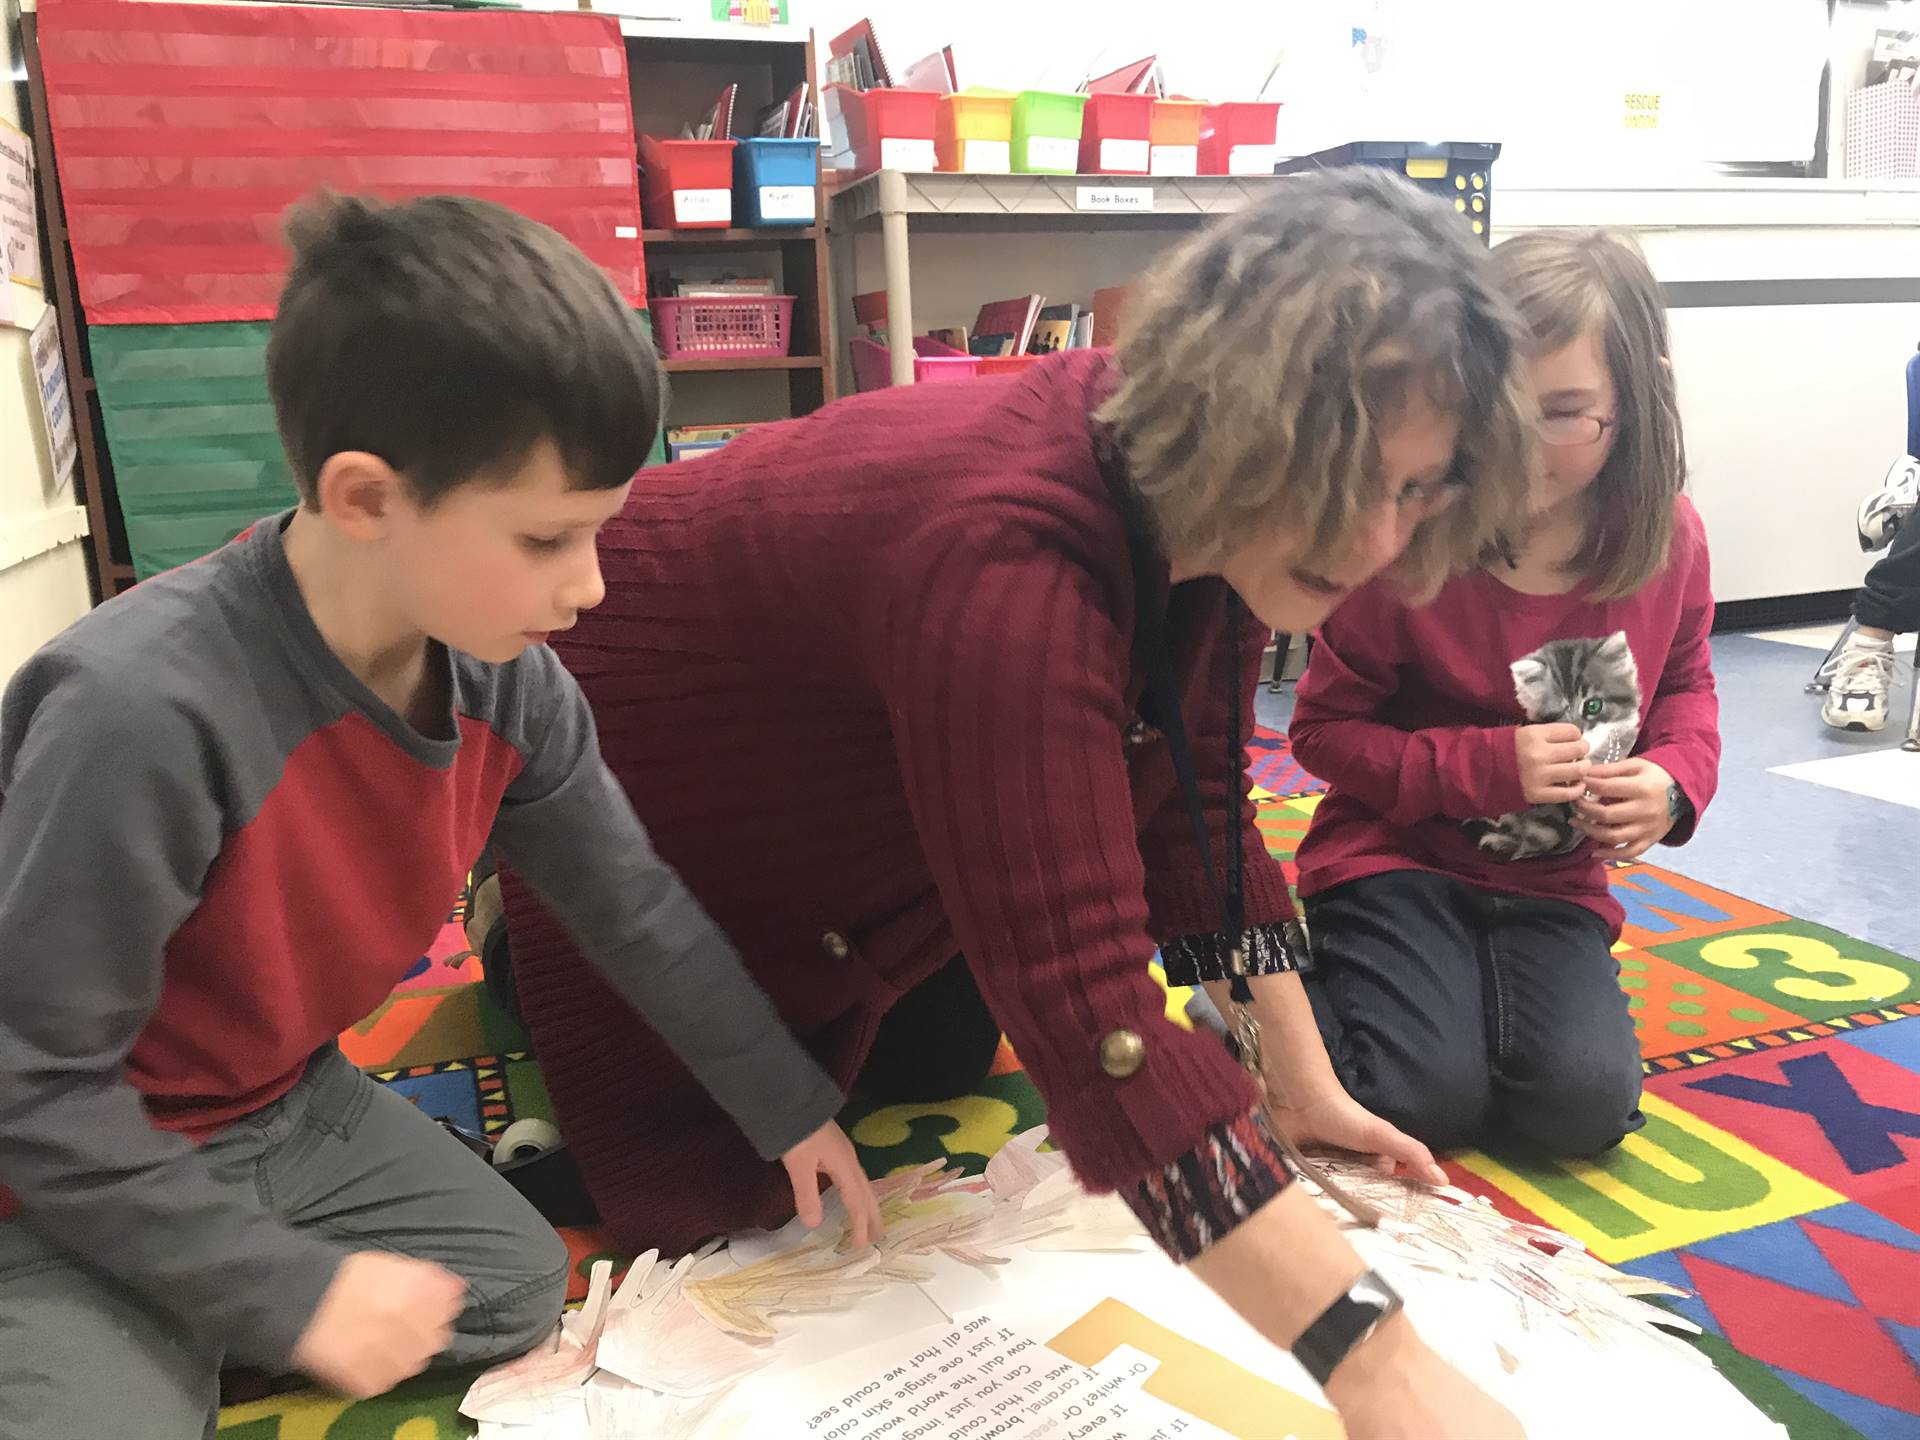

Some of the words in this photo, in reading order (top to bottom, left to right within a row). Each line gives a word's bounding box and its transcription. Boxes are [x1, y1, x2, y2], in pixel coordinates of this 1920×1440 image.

[1624, 94, 1661, 110] RESCUE
[1091, 194, 1110, 204] Book
[1114, 194, 1139, 204] Boxes
[1699, 933, 1911, 1001] 3
[1682, 1051, 1920, 1174] X
[963, 1315, 991, 1333] was
[942, 1331, 961, 1348] all
[996, 1327, 1015, 1342] If
[966, 1336, 996, 1358] just
[1007, 1338, 1037, 1357] how
[908, 1346, 942, 1368] that
[938, 1356, 964, 1373] one
[977, 1355, 1005, 1375] dull
[883, 1367, 907, 1382] we
[1003, 1364, 1032, 1381] Can
[1045, 1363, 1073, 1381] was
[1082, 1367, 1100, 1381] If
[1128, 1362, 1148, 1377] Or
[894, 1372, 937, 1398] single
[950, 1373, 979, 1390] the
[975, 1379, 1003, 1399] you
[1023, 1380, 1043, 1394] all
[841, 1381, 881, 1408] could
[1020, 1377, 1080, 1415] caramel,
[1082, 1376, 1127, 1407] white?
[861, 1398, 893, 1418] skin
[907, 1390, 950, 1417] world
[945, 1397, 976, 1420] just
[990, 1393, 1025, 1417] that
[1062, 1405, 1083, 1420] Or
[1110, 1404, 1129, 1418] If
[805, 1405, 840, 1430] see?
[1170, 1418, 1190, 1433] If
[948, 1416, 988, 1440] could
[1062, 1415, 1108, 1440] every
